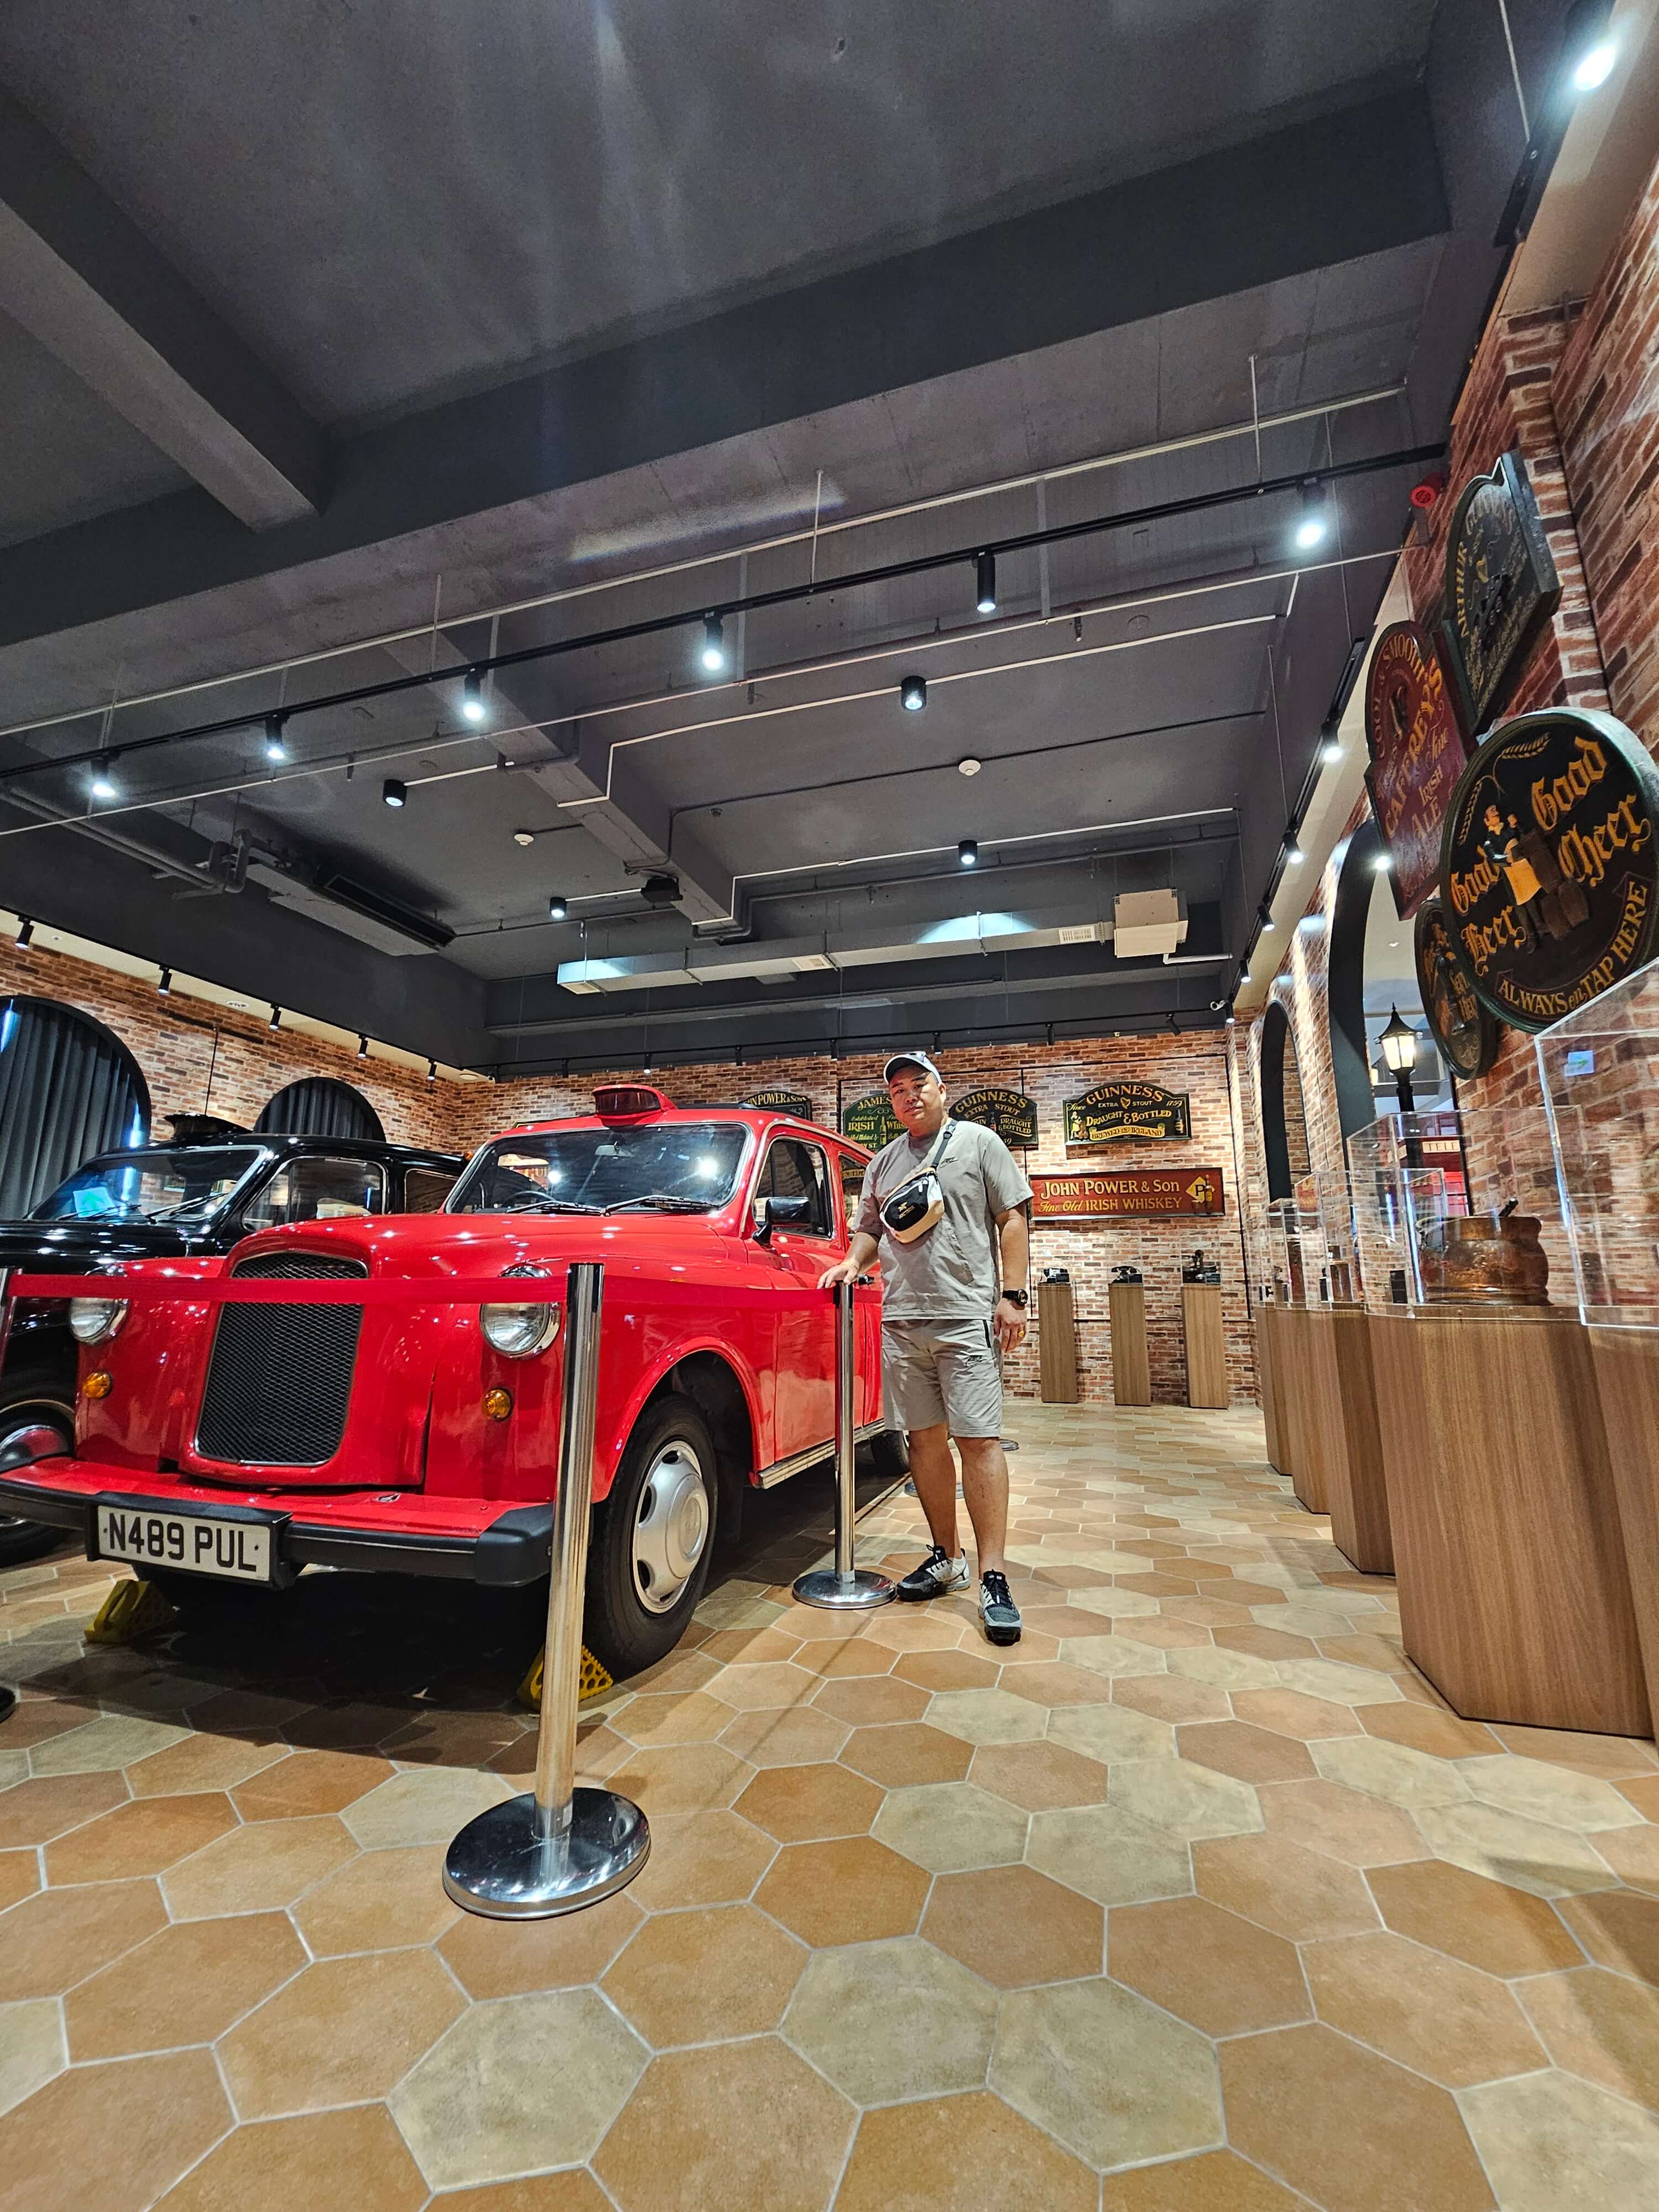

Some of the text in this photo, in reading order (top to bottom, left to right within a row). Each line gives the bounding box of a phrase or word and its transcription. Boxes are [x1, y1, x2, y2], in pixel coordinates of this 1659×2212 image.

[1385, 656, 1443, 838] CAFFREY'S
[1531, 736, 1607, 831] Good
[1411, 796, 1441, 839] ALE
[1558, 794, 1652, 887] Cheer
[1451, 845, 1501, 916] Good
[1461, 905, 1527, 977] Beer
[1497, 979, 1568, 1016] ALWAYS
[1567, 986, 1588, 1010] on
[1579, 956, 1615, 995] TAP
[1610, 880, 1648, 964] HERE
[758, 1093, 786, 1105] POWER
[857, 1096, 893, 1110] JAMES
[955, 1091, 1027, 1113] GUINNESS
[1086, 1084, 1165, 1105] GUINNESS
[964, 1103, 1020, 1119] EXTRA STOUT
[1066, 1102, 1086, 1111] Since
[848, 1121, 874, 1132] IRISH
[1000, 1118, 1032, 1129] DRAUGHT
[1086, 1110, 1172, 1126] DRAUGHT & BOTTLED
[1003, 1124, 1031, 1134] BOTTLED
[1092, 1129, 1120, 1139] BREWED
[1131, 1127, 1162, 1136] IRELAND
[1040, 1181, 1080, 1199] JOHN
[1084, 1179, 1140, 1195] POWER
[1141, 1183, 1150, 1193] &
[1038, 1197, 1183, 1213] Fine Old IRISH WHISKEY
[109, 1513, 257, 1572] N489 PUL
